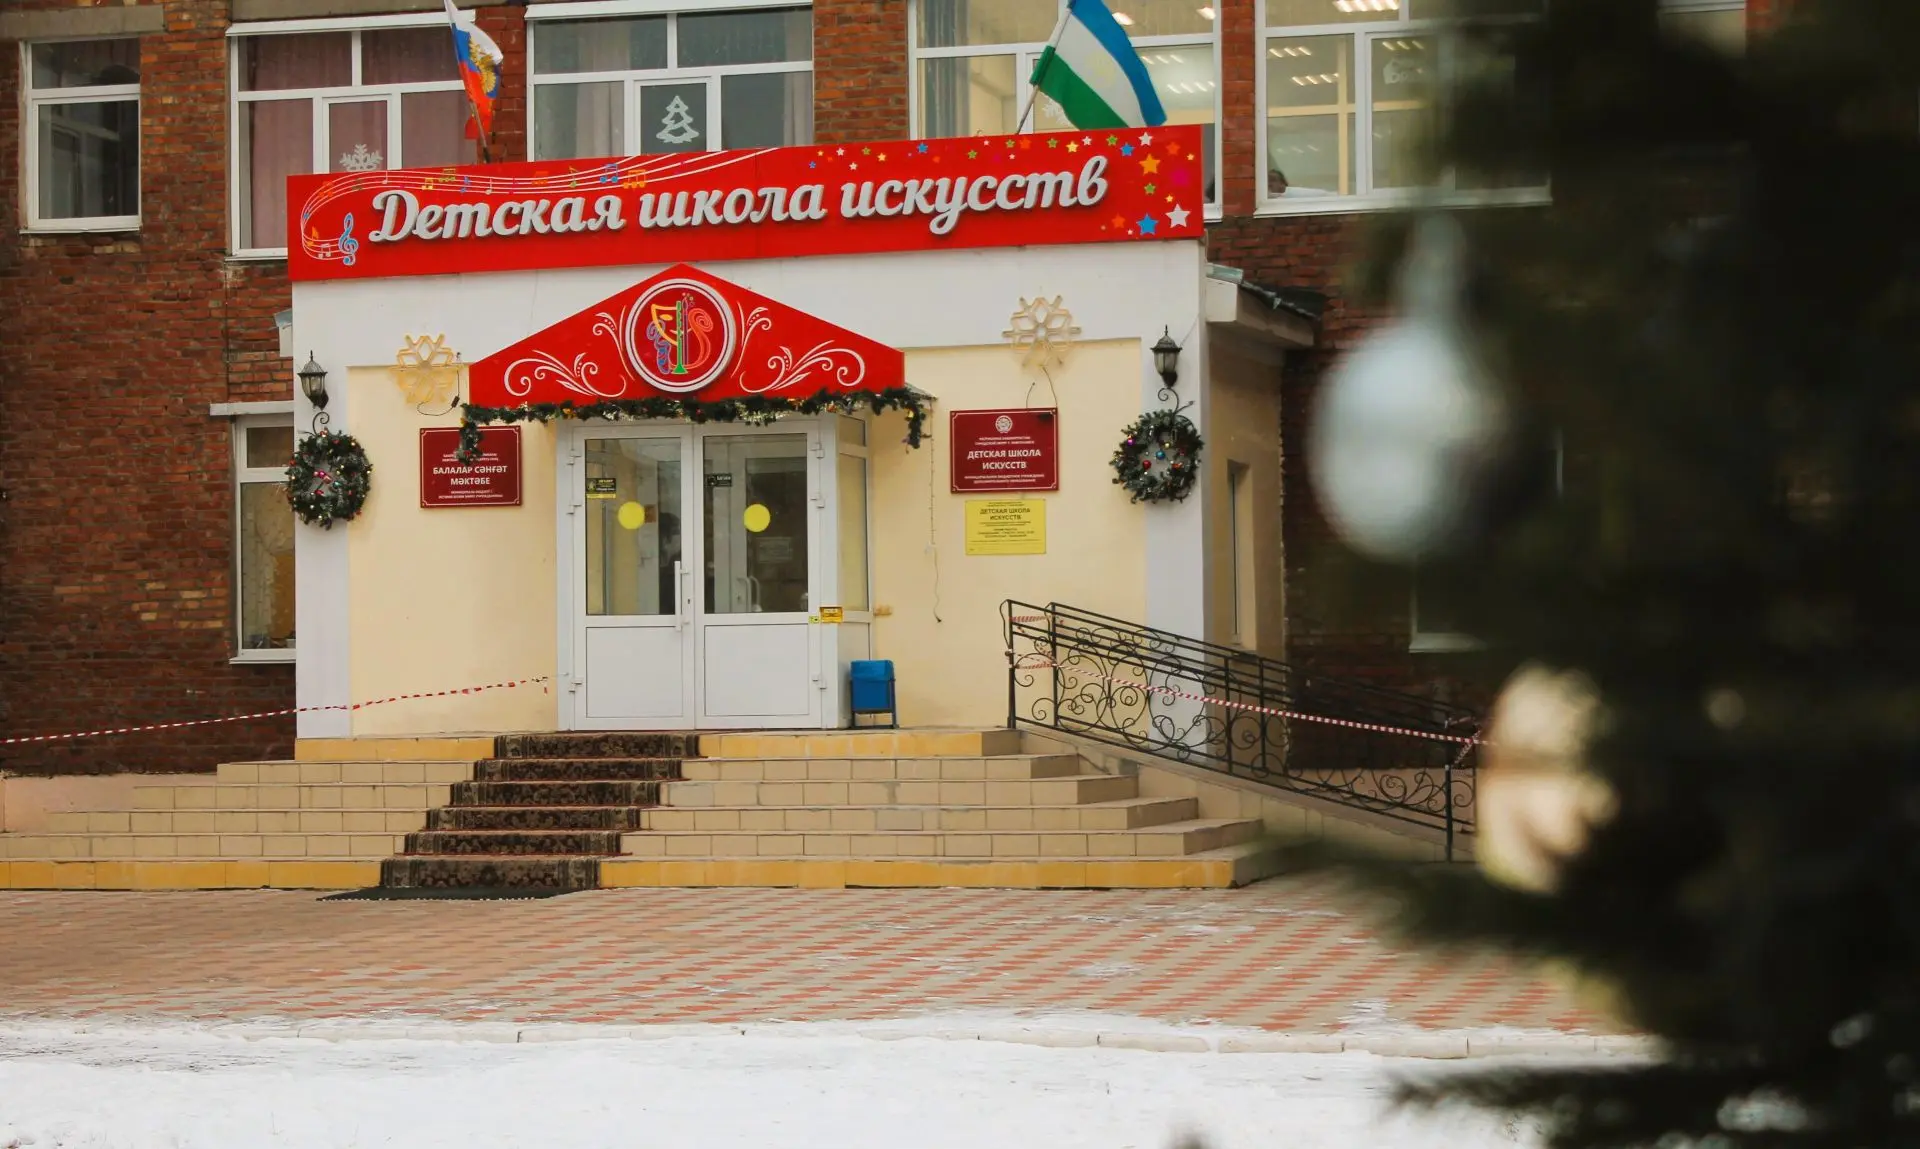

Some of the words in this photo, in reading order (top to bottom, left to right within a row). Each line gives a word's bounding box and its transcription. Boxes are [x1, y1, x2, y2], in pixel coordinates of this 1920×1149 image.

[368, 190, 626, 244] Детская
[638, 183, 827, 230] школа
[840, 155, 1109, 236] искусств
[967, 450, 1006, 459] ДЕТСКАЯ
[1008, 449, 1041, 457] ШКОЛА
[433, 466, 472, 474] БАЛАЛАР
[474, 465, 507, 473] СӘНҒӘТ
[982, 462, 1027, 470] ИСКУССТВ
[450, 477, 490, 485] МӘКТӘБЕ
